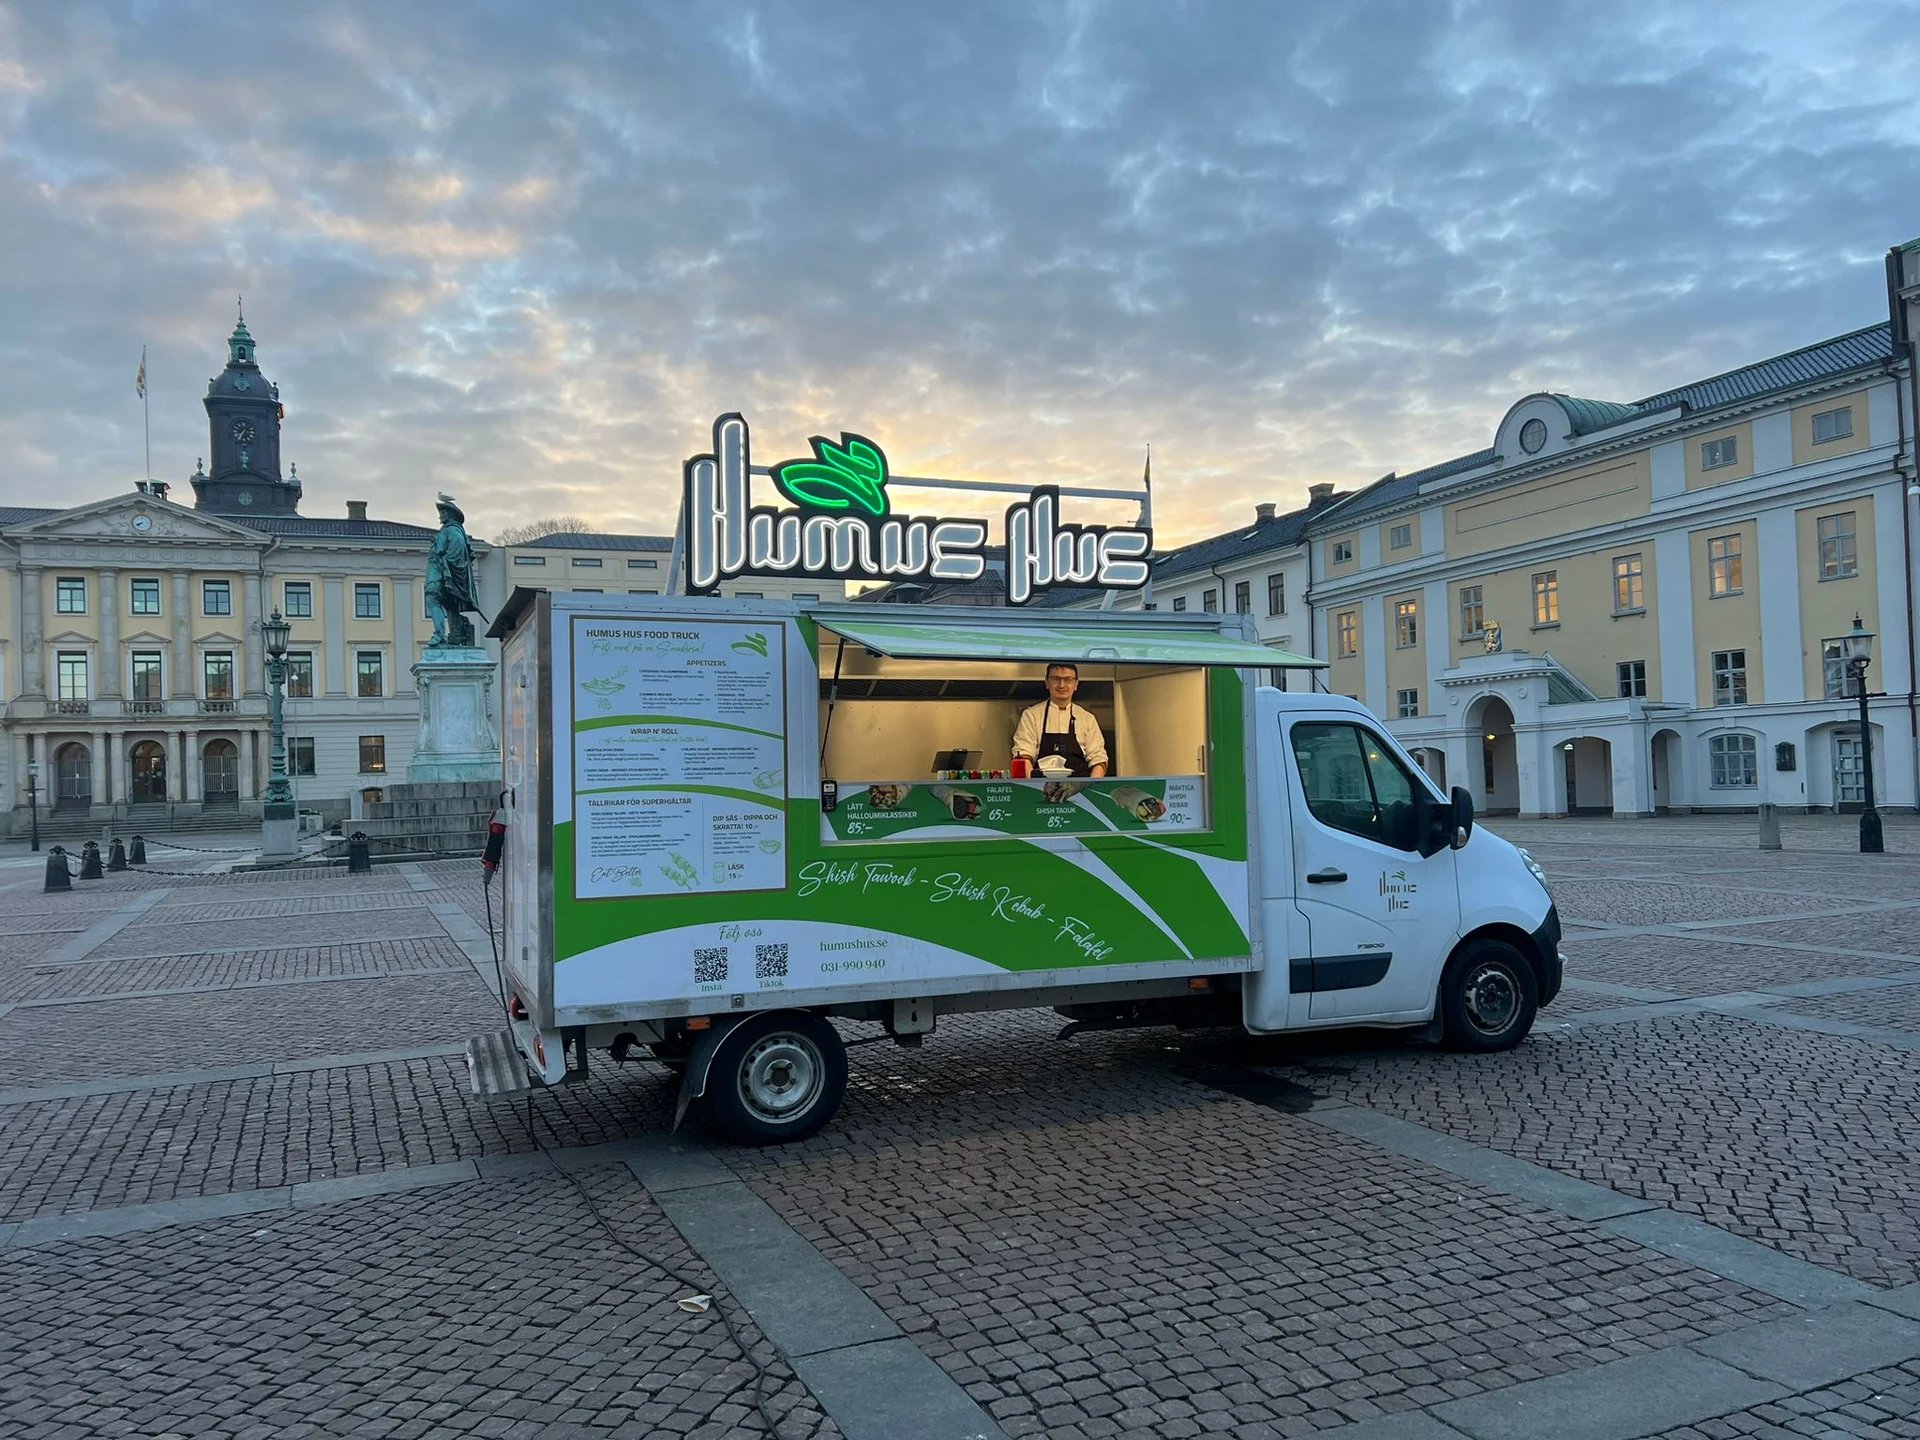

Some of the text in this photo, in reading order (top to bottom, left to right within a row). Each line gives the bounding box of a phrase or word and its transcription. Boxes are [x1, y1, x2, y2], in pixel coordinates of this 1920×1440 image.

[586, 629, 699, 640] HUMUS HUS FOOD TRUCK
[986, 786, 1013, 794] FALAFEL
[588, 799, 625, 807] TALLRIKAR
[626, 798, 640, 806] FÖR
[987, 795, 1012, 803] DELUXE
[847, 811, 918, 820] HALLOUMIKLASSIKER
[1036, 807, 1055, 815] SHISH
[797, 861, 859, 897] Shish
[862, 863, 917, 894] Tawook
[929, 872, 991, 902] Shish
[991, 886, 1046, 923] Kebab
[1054, 916, 1113, 960] Falafel
[718, 924, 763, 941] Följ oss
[820, 938, 888, 952] humushus.se
[821, 959, 885, 972] 031-990 940
[701, 983, 722, 992] Insta
[759, 979, 784, 988] Tiktok
